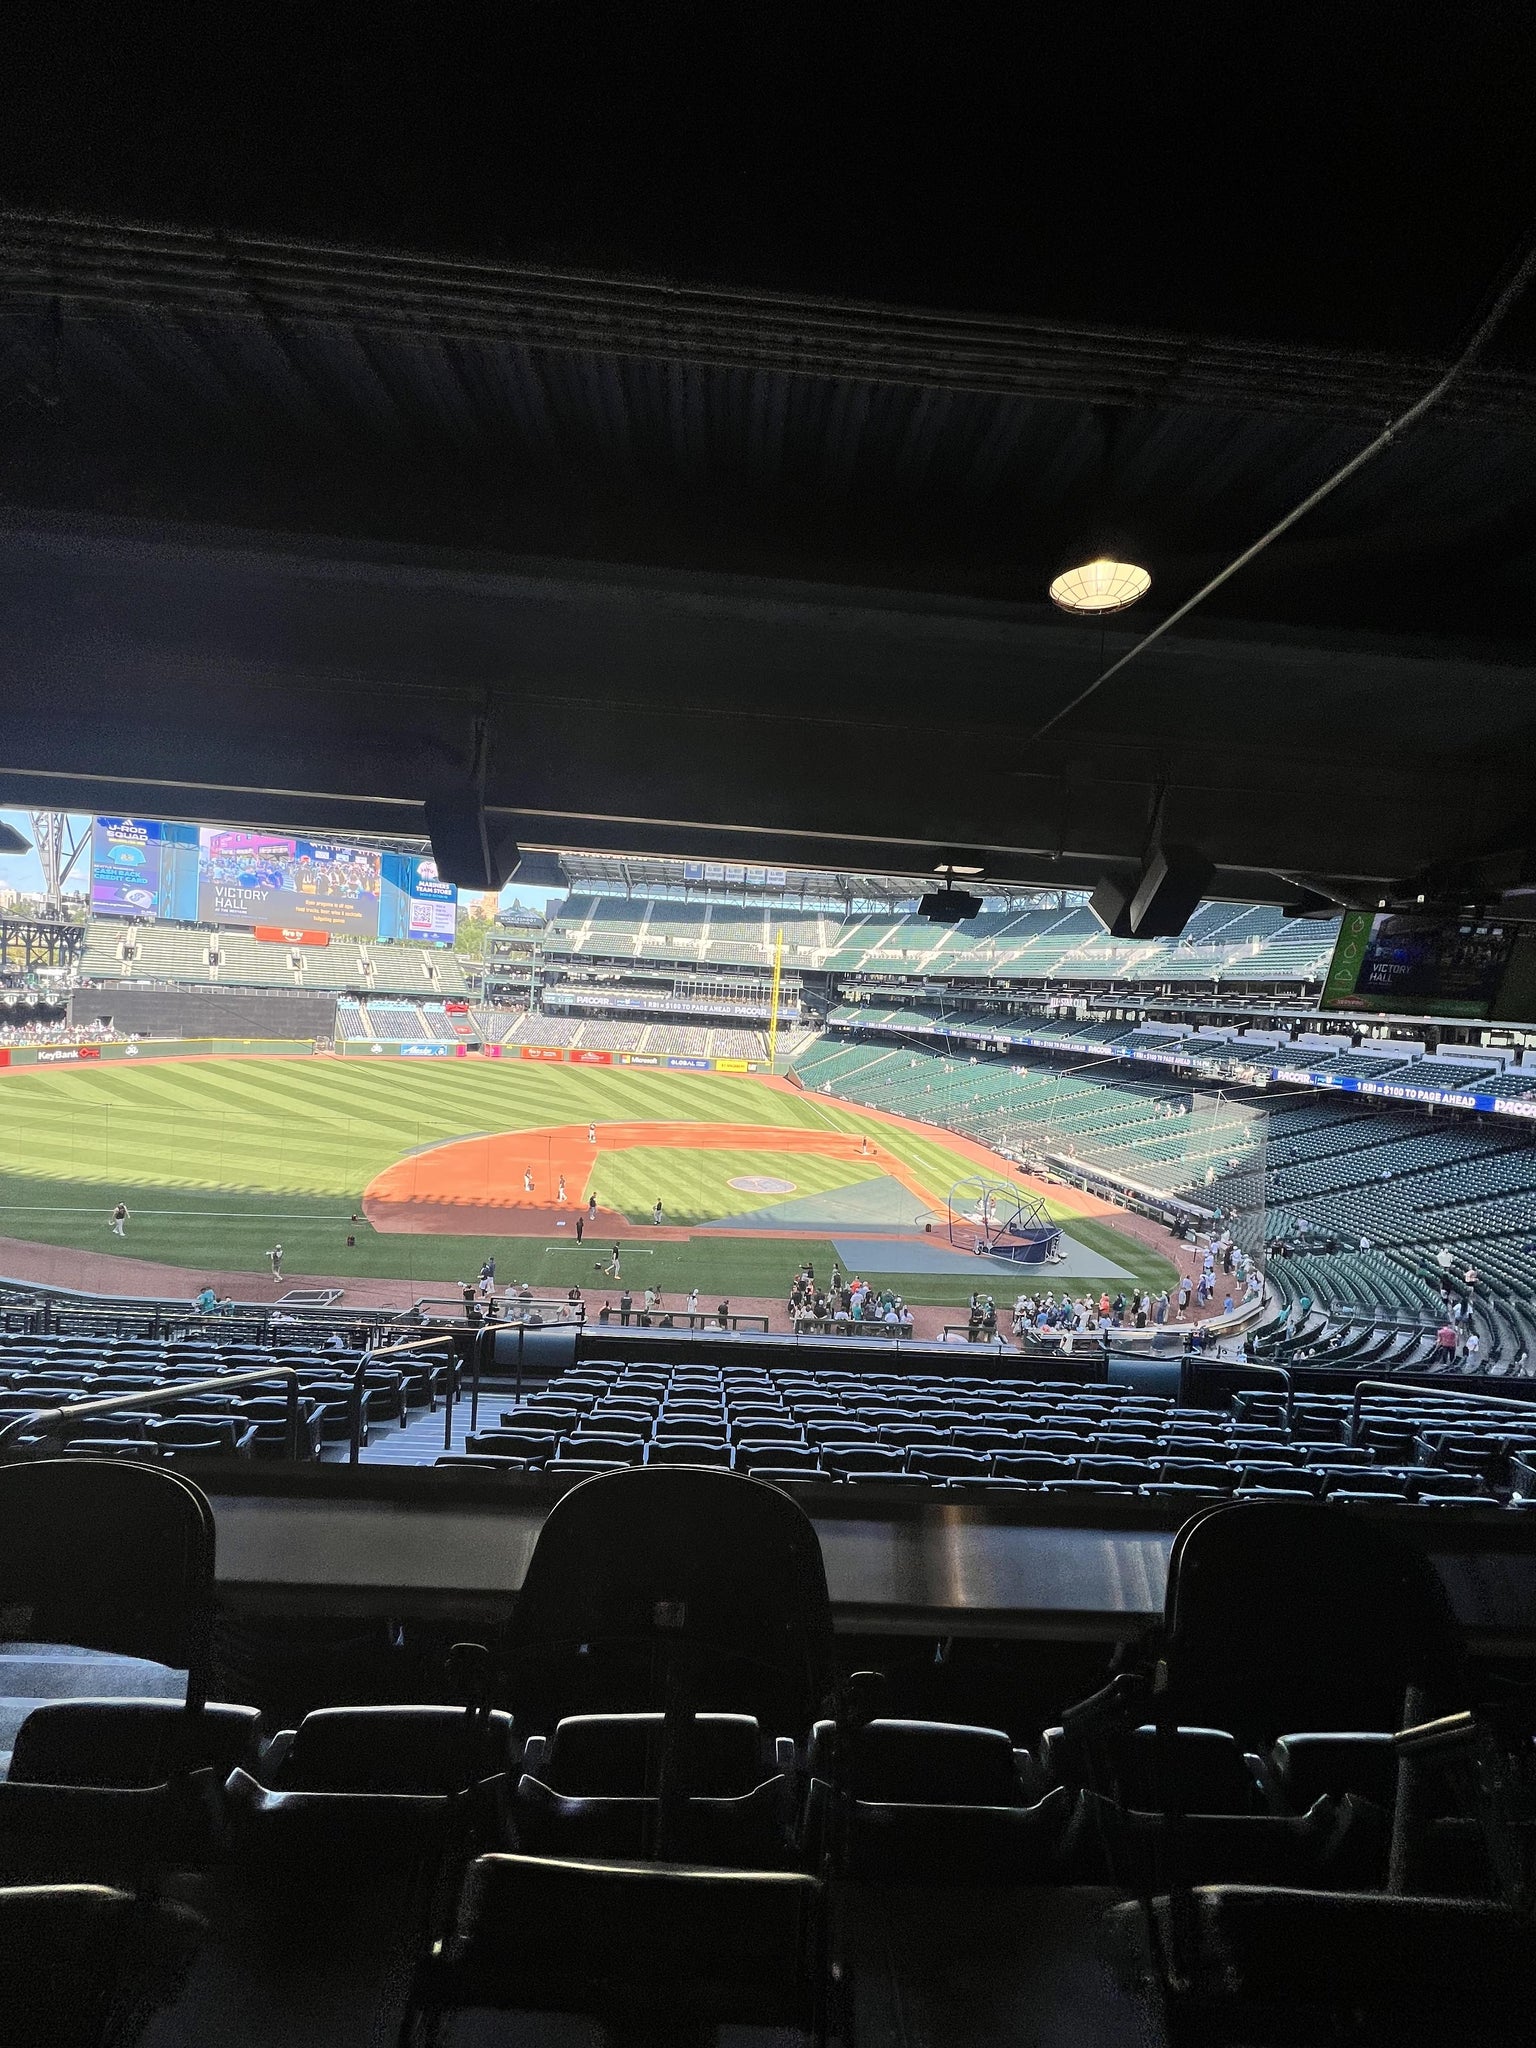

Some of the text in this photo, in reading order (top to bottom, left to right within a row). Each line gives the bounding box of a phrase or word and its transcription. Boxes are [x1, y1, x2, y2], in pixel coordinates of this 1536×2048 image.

[108, 824, 147, 834] J-ROD
[107, 831, 148, 841] SQUAD
[94, 868, 141, 878] CASH BACK
[419, 880, 450, 890] MARINERS
[215, 886, 268, 901] VICTORY
[434, 887, 452, 896] STORE
[215, 897, 248, 910] HALL
[1372, 963, 1412, 974] VICTORY
[1369, 973, 1392, 982] HALL
[576, 996, 610, 1005] PACCAR
[710, 1005, 731, 1013] AHEAD
[735, 1007, 767, 1016] PACCAR
[38, 1050, 79, 1061] KeyBank
[631, 1056, 658, 1065] Microsoft
[670, 1059, 695, 1067] GLOBAL
[1277, 1070, 1311, 1084] PACCAR
[1357, 1081, 1361, 1091] 1
[1362, 1082, 1377, 1093] RBI
[1383, 1084, 1405, 1097] $100
[1405, 1088, 1417, 1099] TO
[1417, 1089, 1441, 1102] PAGE
[1441, 1093, 1476, 1107] AHEAD
